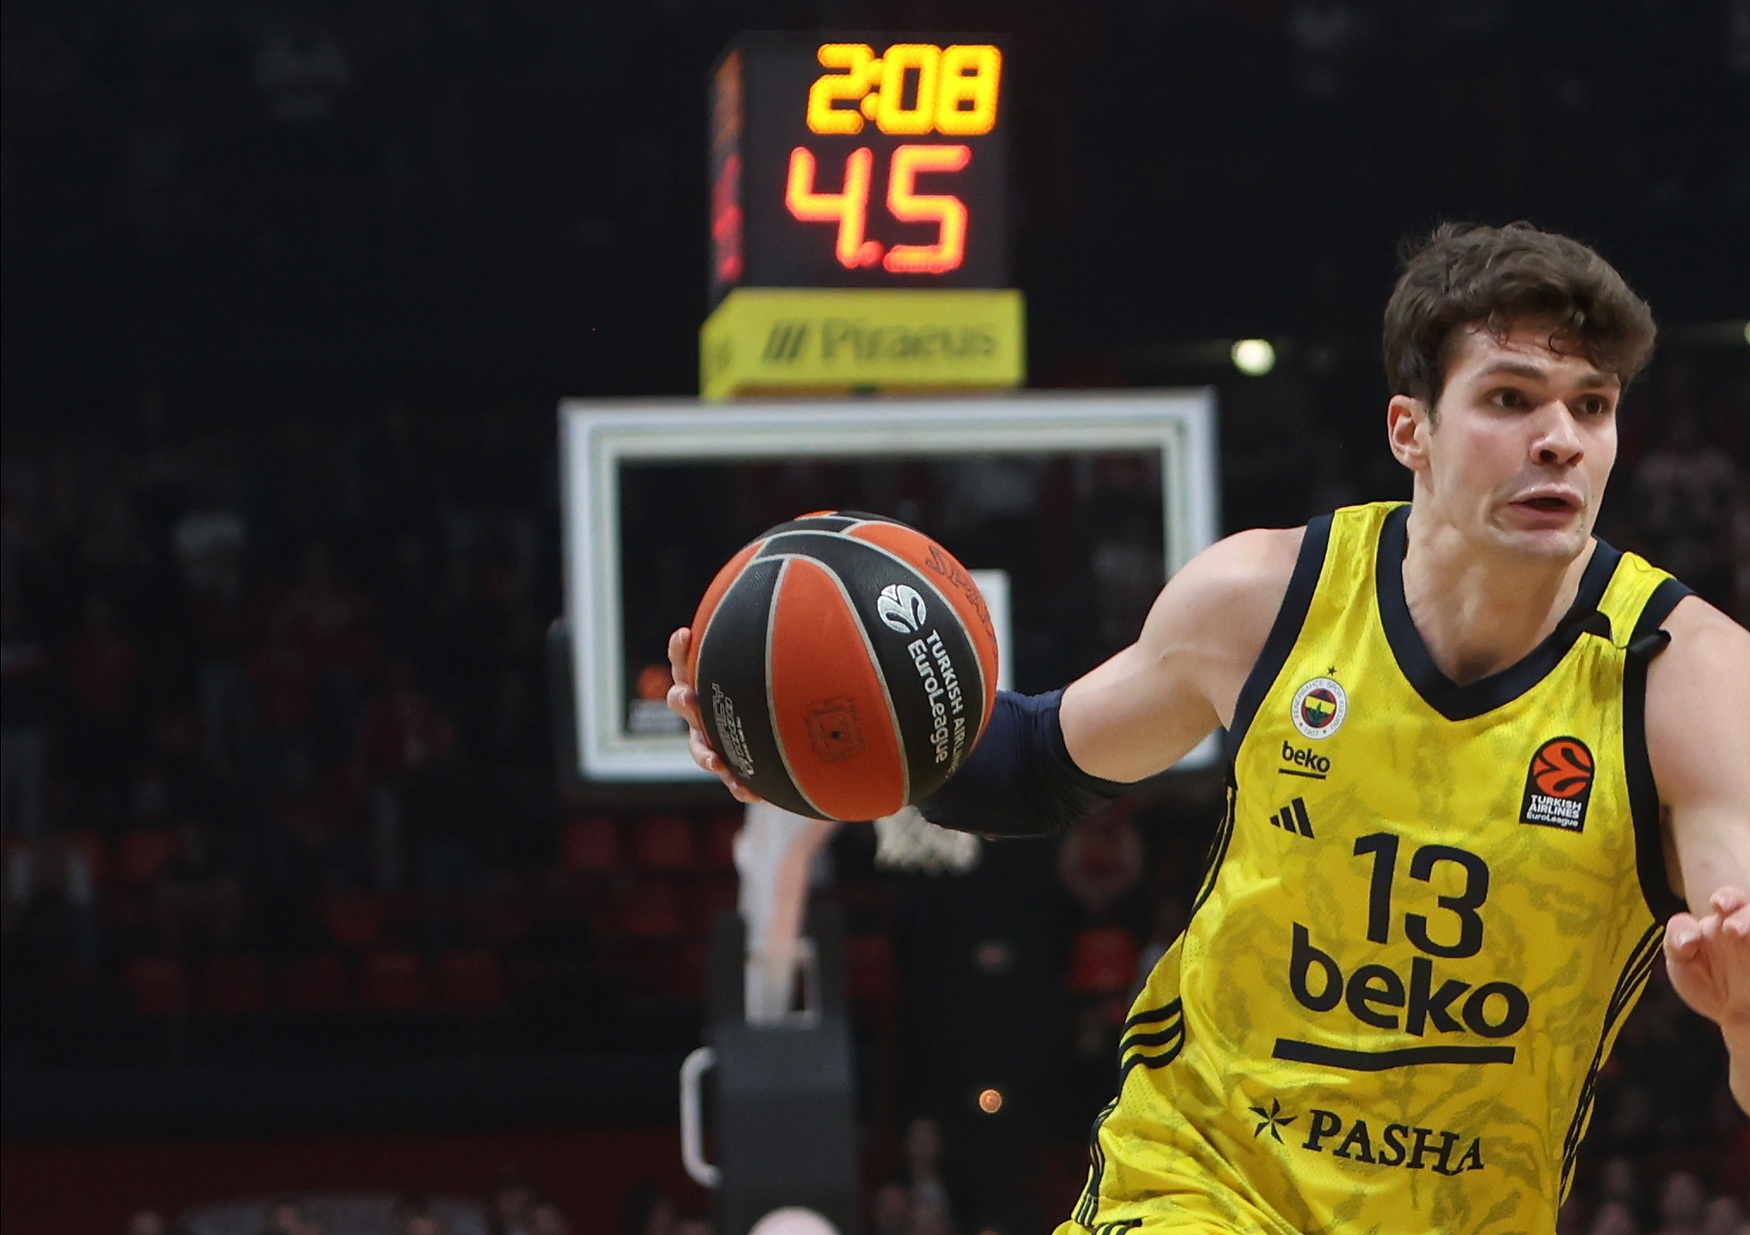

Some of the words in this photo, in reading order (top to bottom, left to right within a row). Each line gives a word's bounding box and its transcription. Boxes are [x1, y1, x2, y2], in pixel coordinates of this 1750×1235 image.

[806, 43, 1002, 135] 2:08
[786, 145, 972, 275] 4.5
[821, 317, 997, 362] Piraeus
[907, 639, 949, 764] EuroLeague
[926, 629, 964, 715] TURKISH
[1282, 740, 1331, 772] beko
[1526, 811, 1579, 827] EuroLeague
[1528, 803, 1579, 819] AIRLINES
[1531, 795, 1582, 811] TURKISH
[1353, 833, 1490, 959] 13
[1289, 922, 1530, 1038] beko
[1302, 1109, 1484, 1176] PASHA
